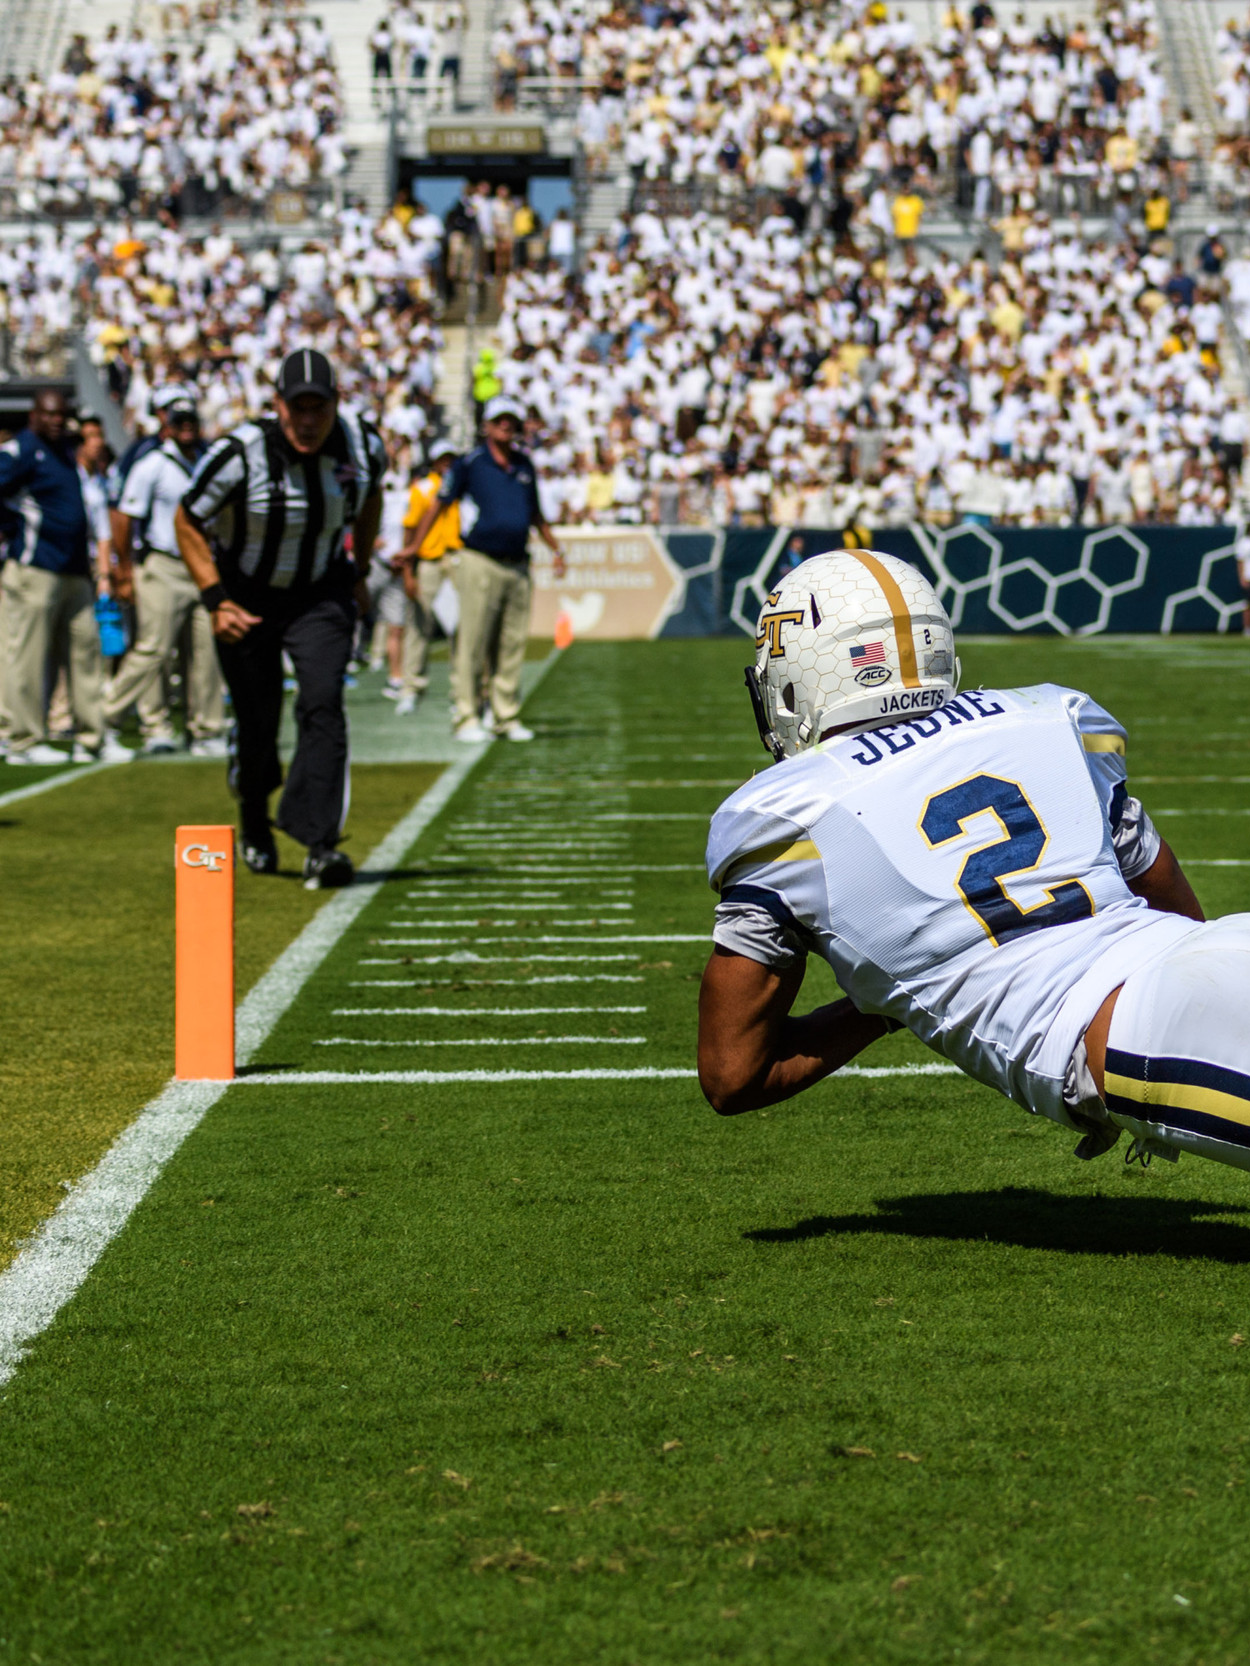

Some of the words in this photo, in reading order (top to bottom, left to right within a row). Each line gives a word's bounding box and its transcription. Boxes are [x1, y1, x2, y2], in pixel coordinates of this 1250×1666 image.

[923, 629, 931, 645] 2
[860, 670, 886, 681] ACC
[880, 689, 944, 714] JACKETS
[916, 770, 1097, 948] 2
